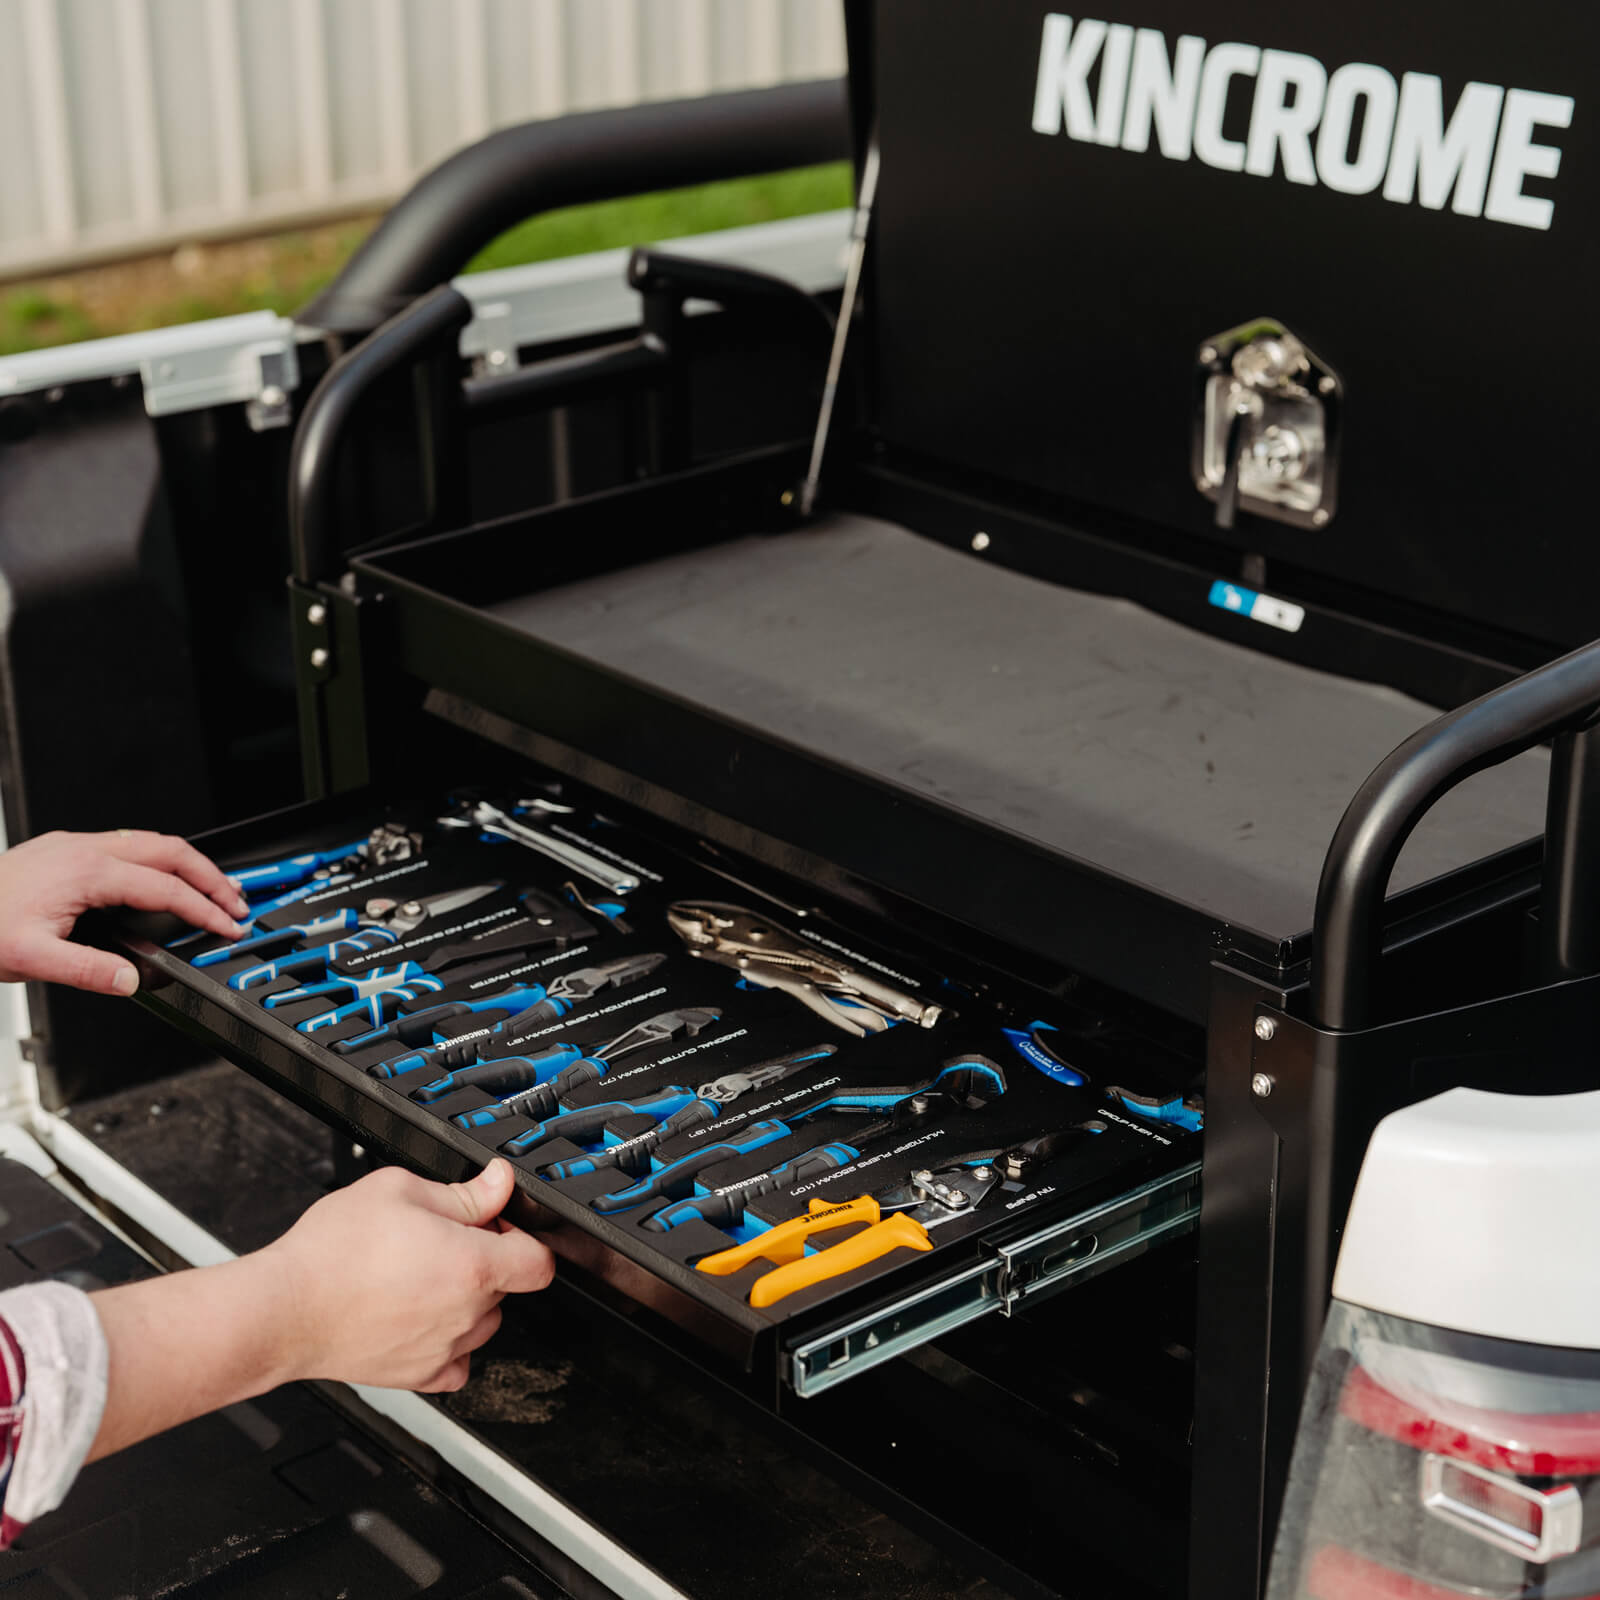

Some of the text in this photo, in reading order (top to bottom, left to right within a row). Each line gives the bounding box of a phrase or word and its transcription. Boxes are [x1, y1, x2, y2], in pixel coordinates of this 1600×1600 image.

[1032, 13, 1576, 230] KINCROME
[469, 945, 588, 989] COMPACT HAND RIVETER
[599, 987, 666, 1014] COMBINATION
[564, 1011, 599, 1026] PLIERS
[598, 1028, 747, 1086] DIAGONAL CUTTER 175MM (7")
[811, 1076, 840, 1090] LONG
[782, 1087, 812, 1101] NOSE
[747, 1099, 782, 1115] PLIERS
[1097, 1108, 1129, 1124] CIRCLIP
[706, 1112, 747, 1131] 200MM
[790, 1129, 944, 1196] MULTIGRIP PLIERS 250MM (10")
[722, 1173, 768, 1193] KINCROME
[1005, 1186, 1055, 1209] TIN SNIPS
